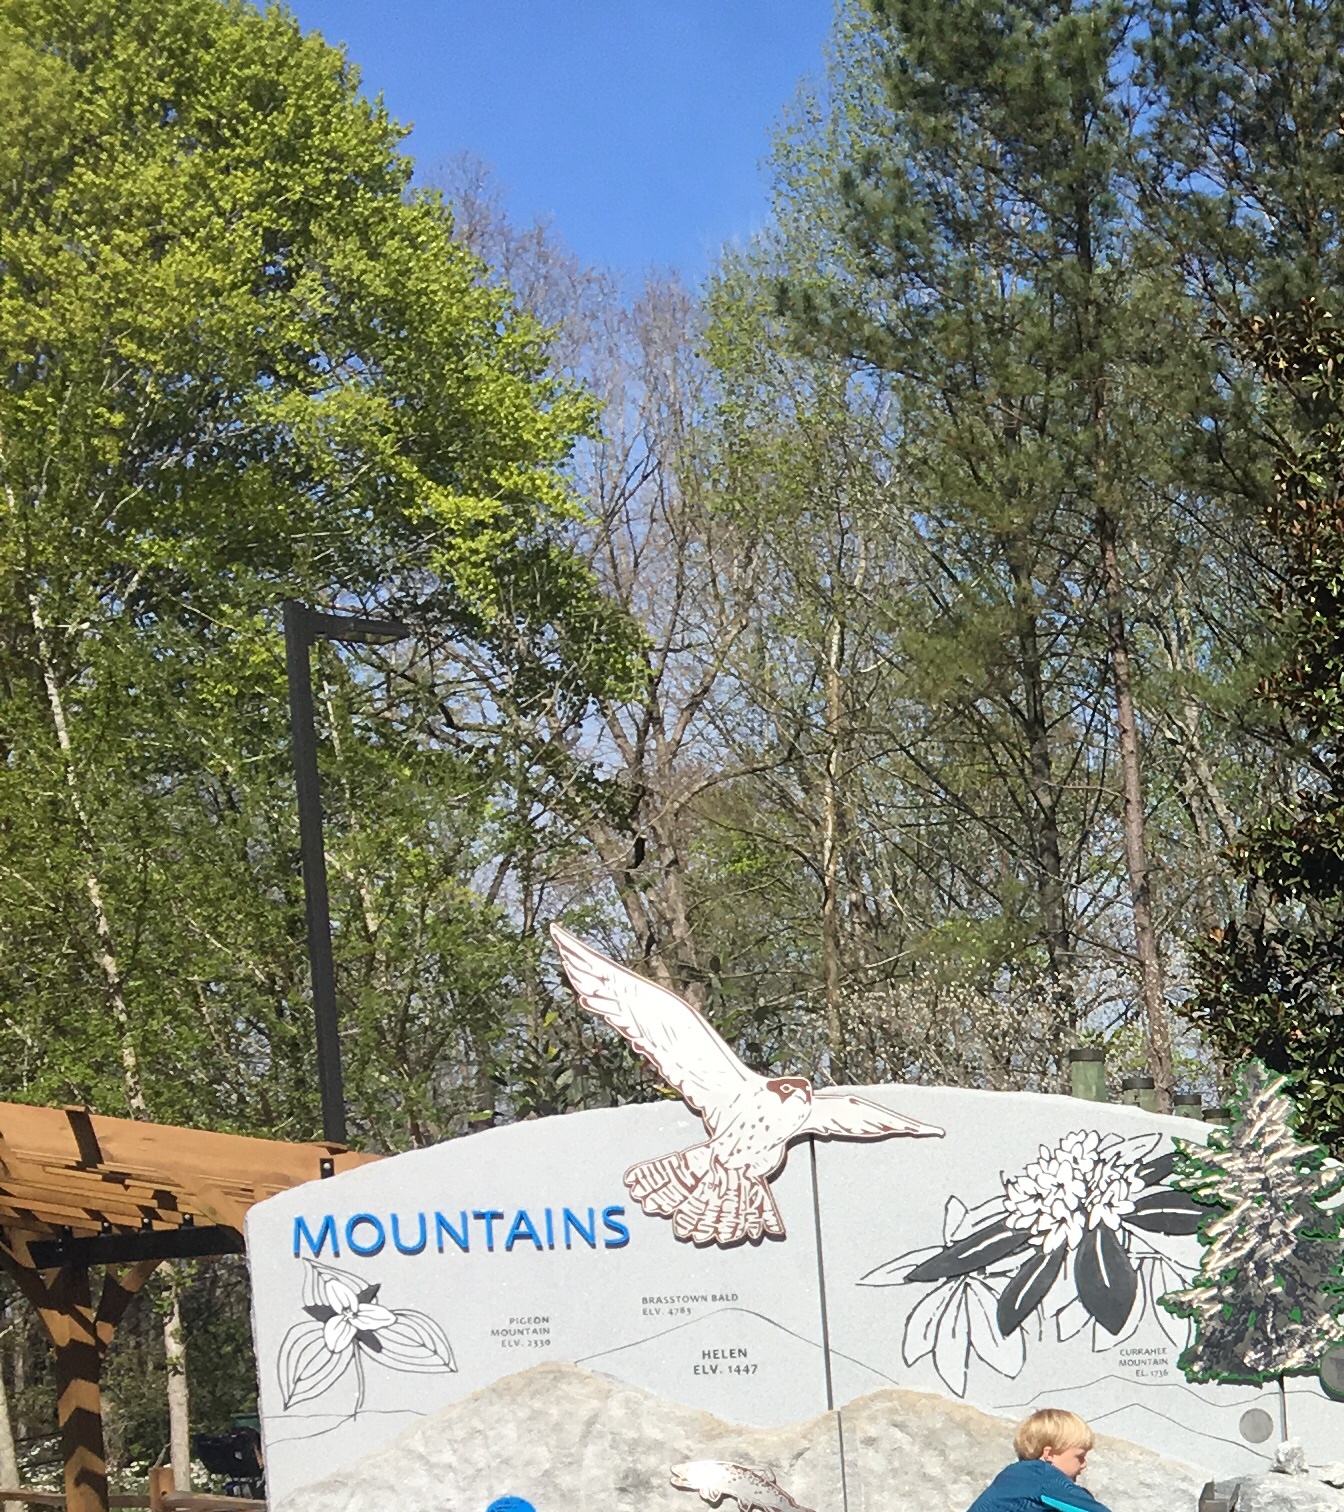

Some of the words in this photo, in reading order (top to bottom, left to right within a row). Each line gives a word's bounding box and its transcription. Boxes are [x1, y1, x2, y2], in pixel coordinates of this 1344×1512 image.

[293, 1205, 631, 1258] MOUNTAINS
[641, 1294, 708, 1305] BRASSTOWN
[711, 1293, 739, 1303] BALD
[509, 1316, 550, 1325] PIGEON
[490, 1327, 550, 1337] MOUNTAIN
[701, 1348, 748, 1360] HELEN
[1119, 1347, 1168, 1356] CURRAHEE
[1118, 1358, 1169, 1367] MOUNTAIN
[693, 1364, 723, 1376] ELV.
[727, 1363, 759, 1376] 1447
